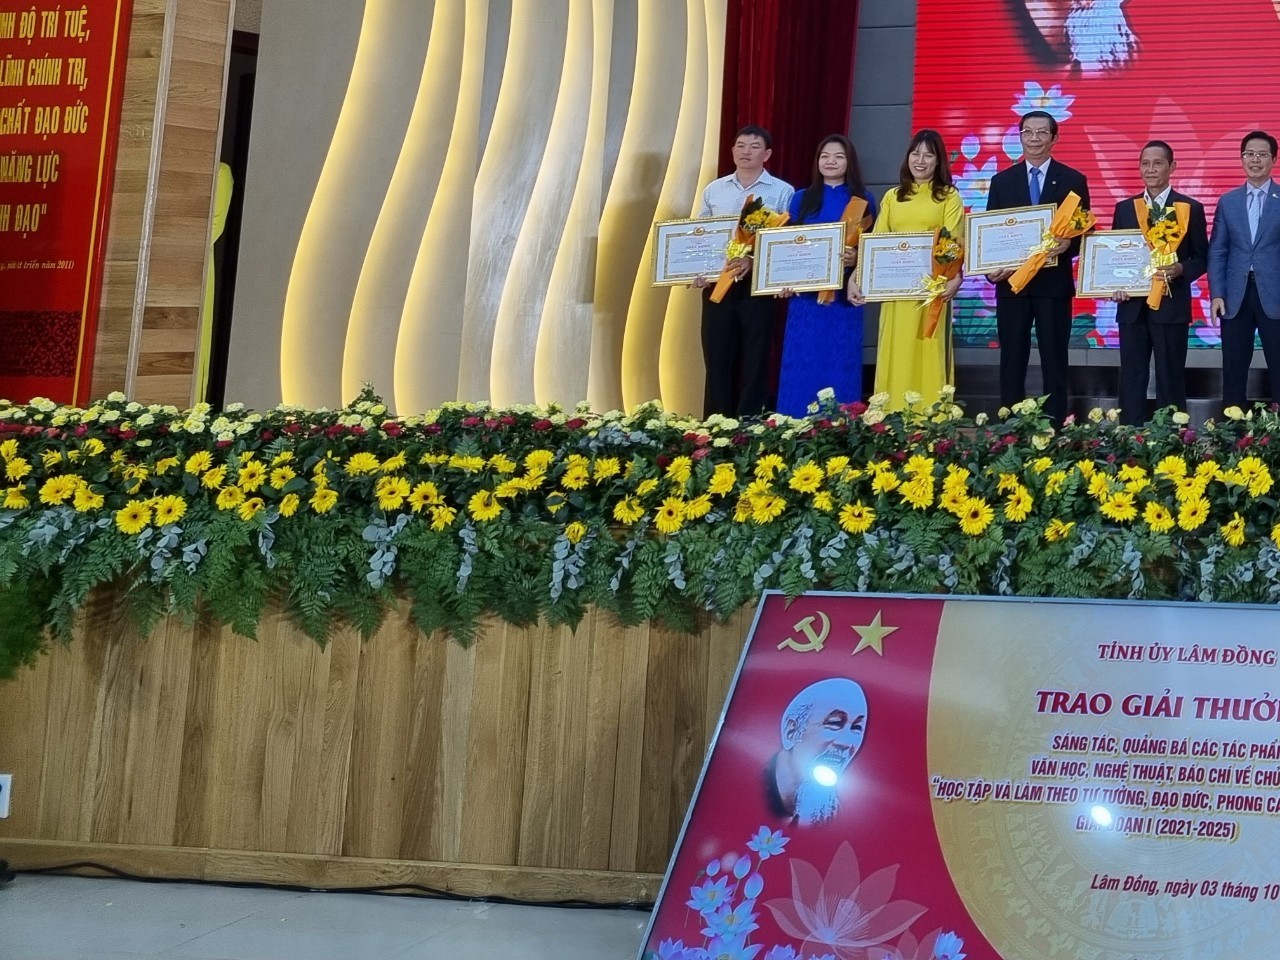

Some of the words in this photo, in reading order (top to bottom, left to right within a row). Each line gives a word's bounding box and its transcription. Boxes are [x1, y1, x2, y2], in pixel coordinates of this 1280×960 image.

[19, 5, 36, 45] ĐỘ
[40, 4, 60, 38] TRÍ
[64, 4, 90, 43] TUỆ,
[27, 52, 62, 86] CHÍNH
[67, 57, 88, 91] TRỊ,
[34, 105, 60, 140] ĐẠO
[63, 99, 89, 134] ĐỨC
[35, 150, 60, 189] LỰC
[1098, 640, 1143, 660] TỈNH
[1149, 644, 1173, 662] ỦY
[1177, 644, 1216, 663] LÂM
[1221, 644, 1277, 665] ĐỒNG
[1036, 691, 1113, 715] TRAO
[1121, 688, 1184, 718] GIẢI
[1052, 733, 1088, 752] SÁNG
[1091, 734, 1118, 754] TÁC,
[1122, 734, 1167, 755] QUẢNG
[1169, 736, 1187, 755] BÁ
[1191, 737, 1218, 757] CÁC
[1222, 738, 1247, 758] TÁC
[1030, 757, 1056, 776] VĂN
[1060, 762, 1089, 779] HỌC,
[1093, 761, 1128, 782] NGHỆ
[1132, 762, 1173, 784] THUẬT,
[1177, 763, 1204, 783] BÁO
[1208, 764, 1232, 784] CHÍ
[1235, 764, 1252, 785] VỀ
[1254, 766, 1280, 786] CHỦ
[966, 780, 992, 802] TẬP
[994, 781, 1011, 799] VÀ
[1013, 782, 1043, 801] LÀM
[1046, 786, 1078, 803] THEO
[1082, 787, 1100, 803] TƯ
[1102, 785, 1147, 808] TƯỞNG,
[1151, 791, 1179, 810] ĐẠO
[1182, 790, 1212, 811] ĐỨC,
[1216, 794, 1263, 813] PHONG
[1107, 816, 1144, 836] OẠN
[1146, 818, 1152, 833] I
[1156, 818, 1236, 839] (2021-2025)
[1091, 873, 1121, 891] Lâm
[1123, 874, 1159, 896] Đồng,
[1164, 879, 1198, 898] ngày
[1201, 880, 1218, 896] 03
[1221, 882, 1258, 902] tháng
[1263, 884, 1280, 901] 10
